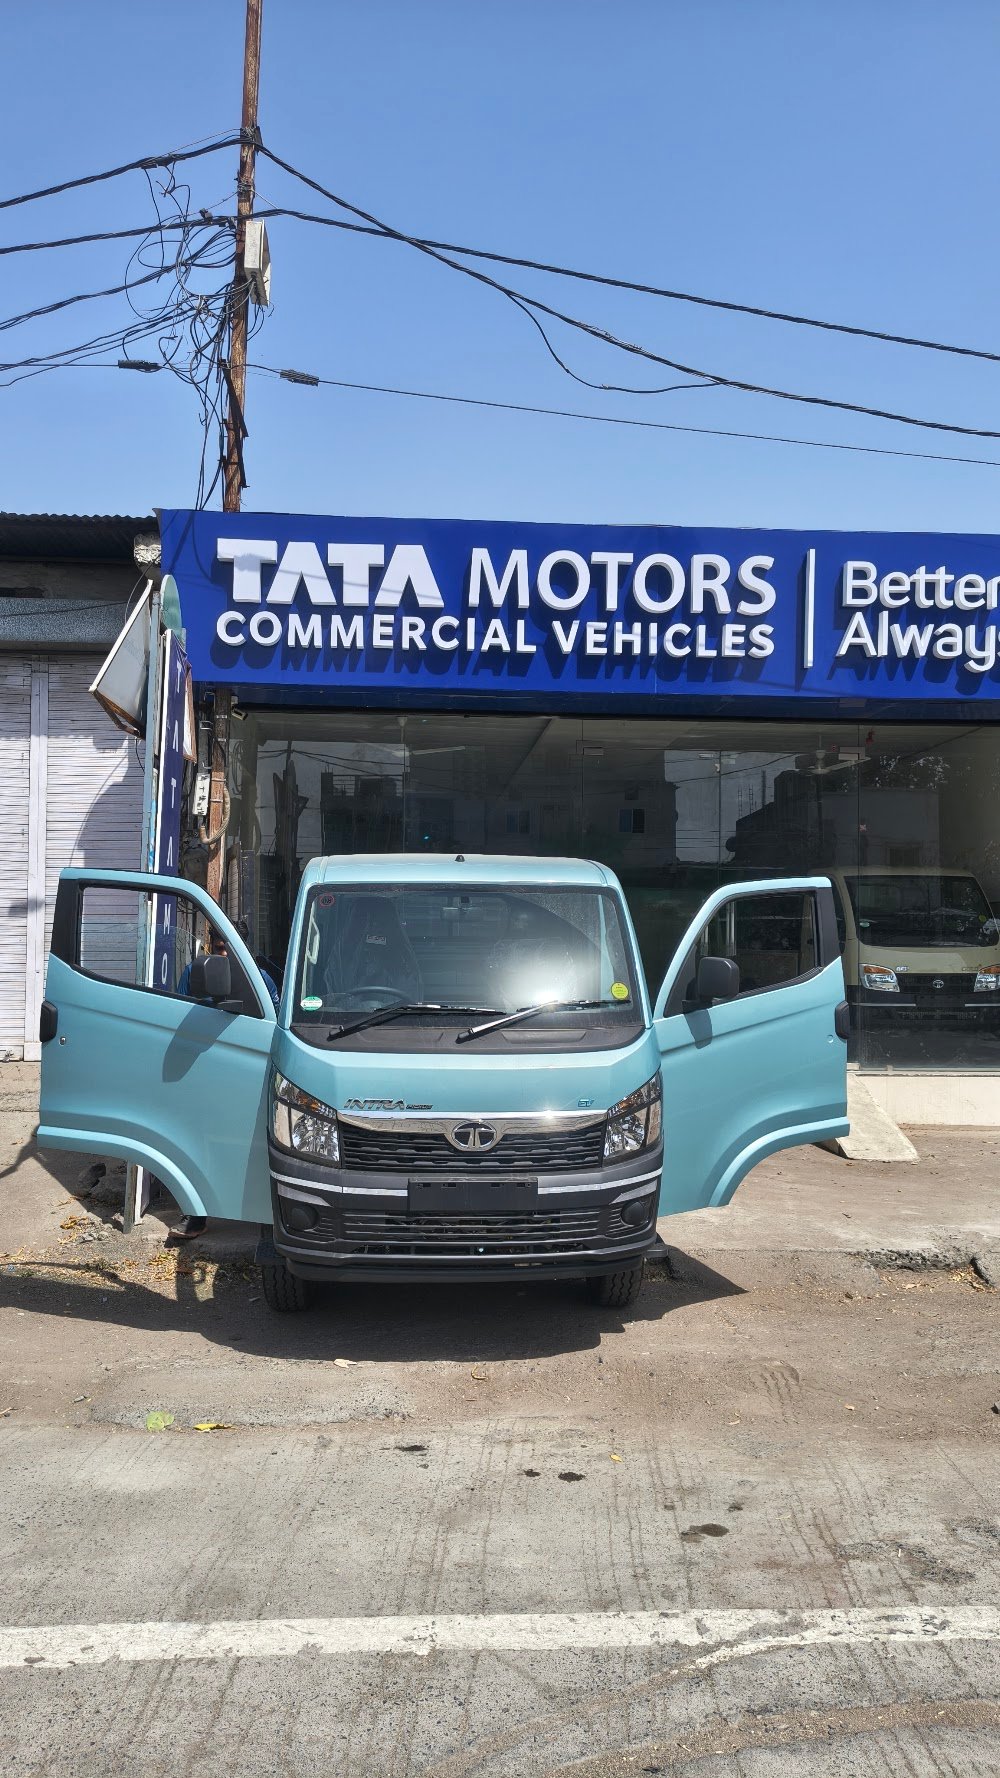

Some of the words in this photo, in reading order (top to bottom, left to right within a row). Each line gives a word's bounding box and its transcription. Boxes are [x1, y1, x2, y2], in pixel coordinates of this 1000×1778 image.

[217, 537, 445, 608] TATA
[468, 548, 776, 615] MOTORS
[842, 560, 1000, 611] Better
[216, 611, 537, 653] COMMERCIAL
[552, 620, 775, 658] VEHICLES
[835, 611, 1000, 673] Alway
[166, 660, 182, 867] TATA
[343, 1097, 405, 1111] INTRA
